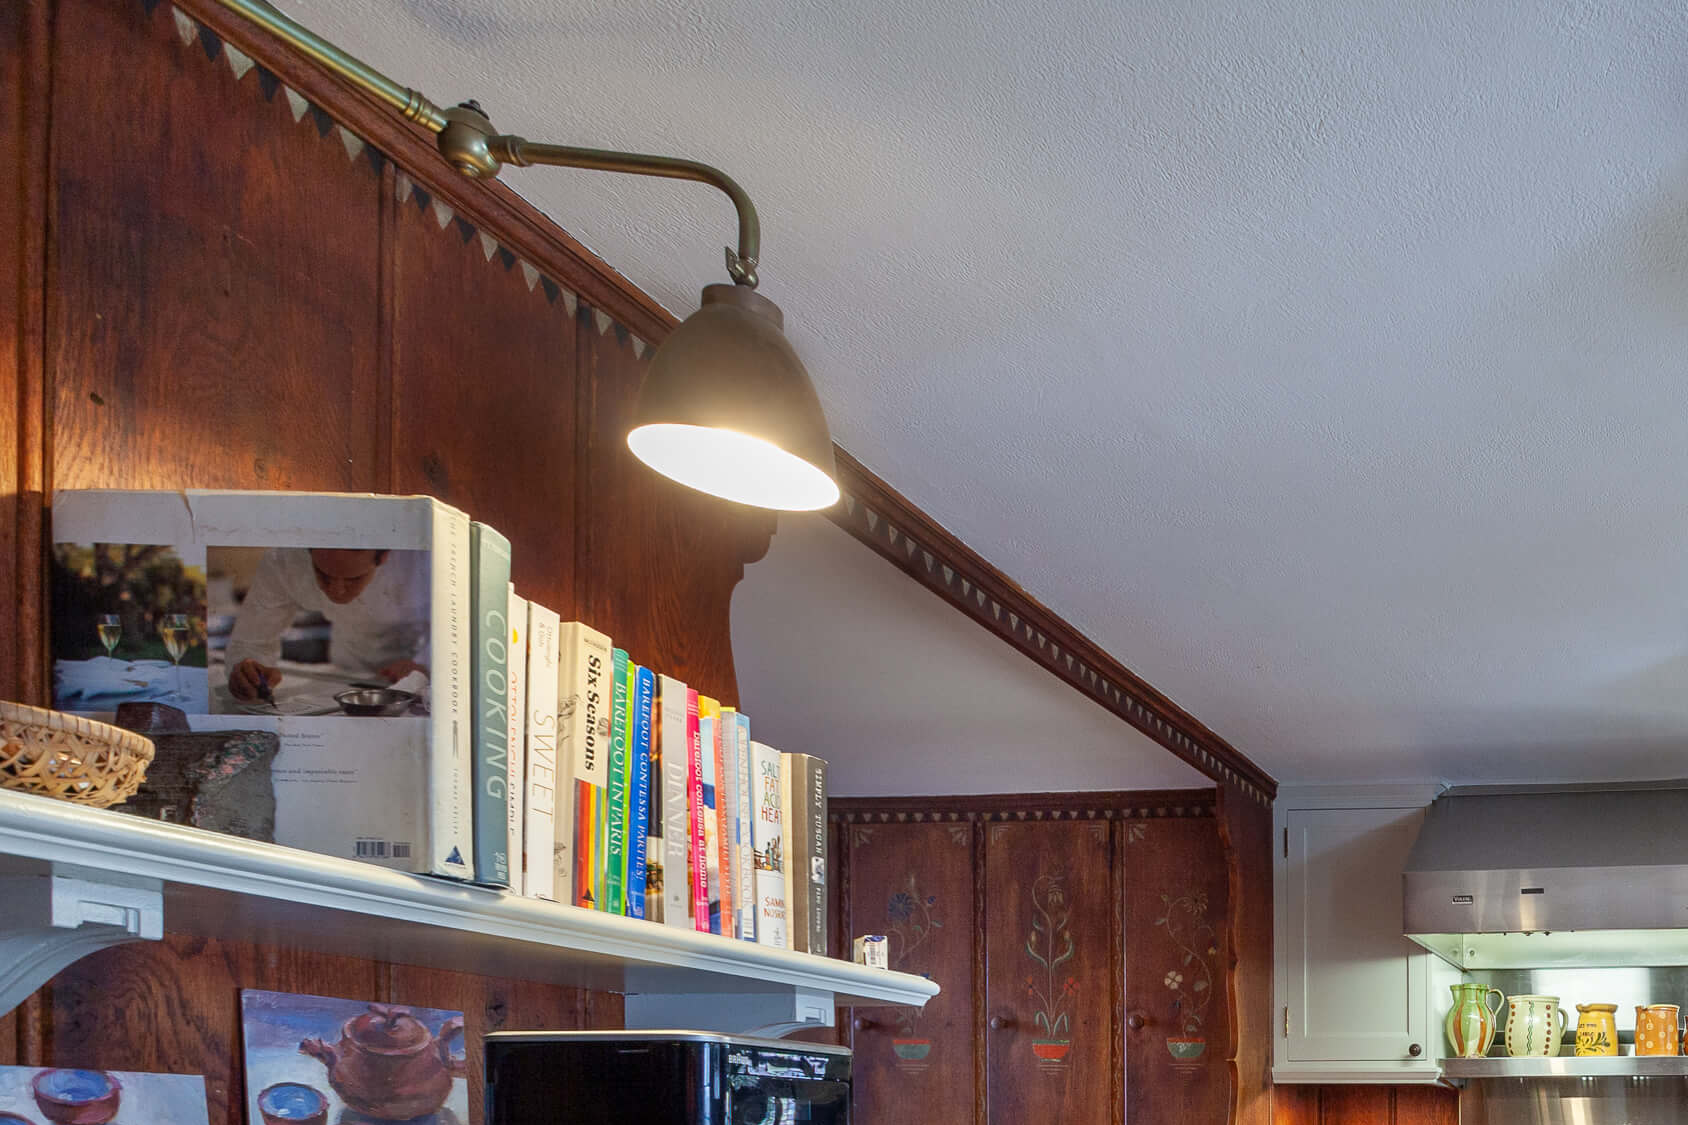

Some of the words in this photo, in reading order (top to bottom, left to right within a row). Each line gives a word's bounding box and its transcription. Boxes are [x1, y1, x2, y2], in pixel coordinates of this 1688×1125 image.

[450, 593, 458, 646] LAUNDRY
[450, 651, 459, 716] COOKBOOK
[587, 654, 602, 686] Six
[485, 608, 508, 802] COOKING
[585, 690, 601, 772] Seasons
[612, 681, 627, 780] BAREFOOT
[641, 677, 651, 748] BAREFOOT
[532, 709, 556, 825] SWEET
[611, 780, 625, 804] IN
[638, 752, 650, 821] CONTESSA
[814, 767, 823, 808] SIMPLY
[610, 805, 625, 857] PARIS
[667, 761, 685, 857] DINNER
[695, 784, 705, 838] contessa
[813, 813, 822, 854] TUSCAN
[698, 839, 706, 852] at
[699, 854, 708, 889] home
